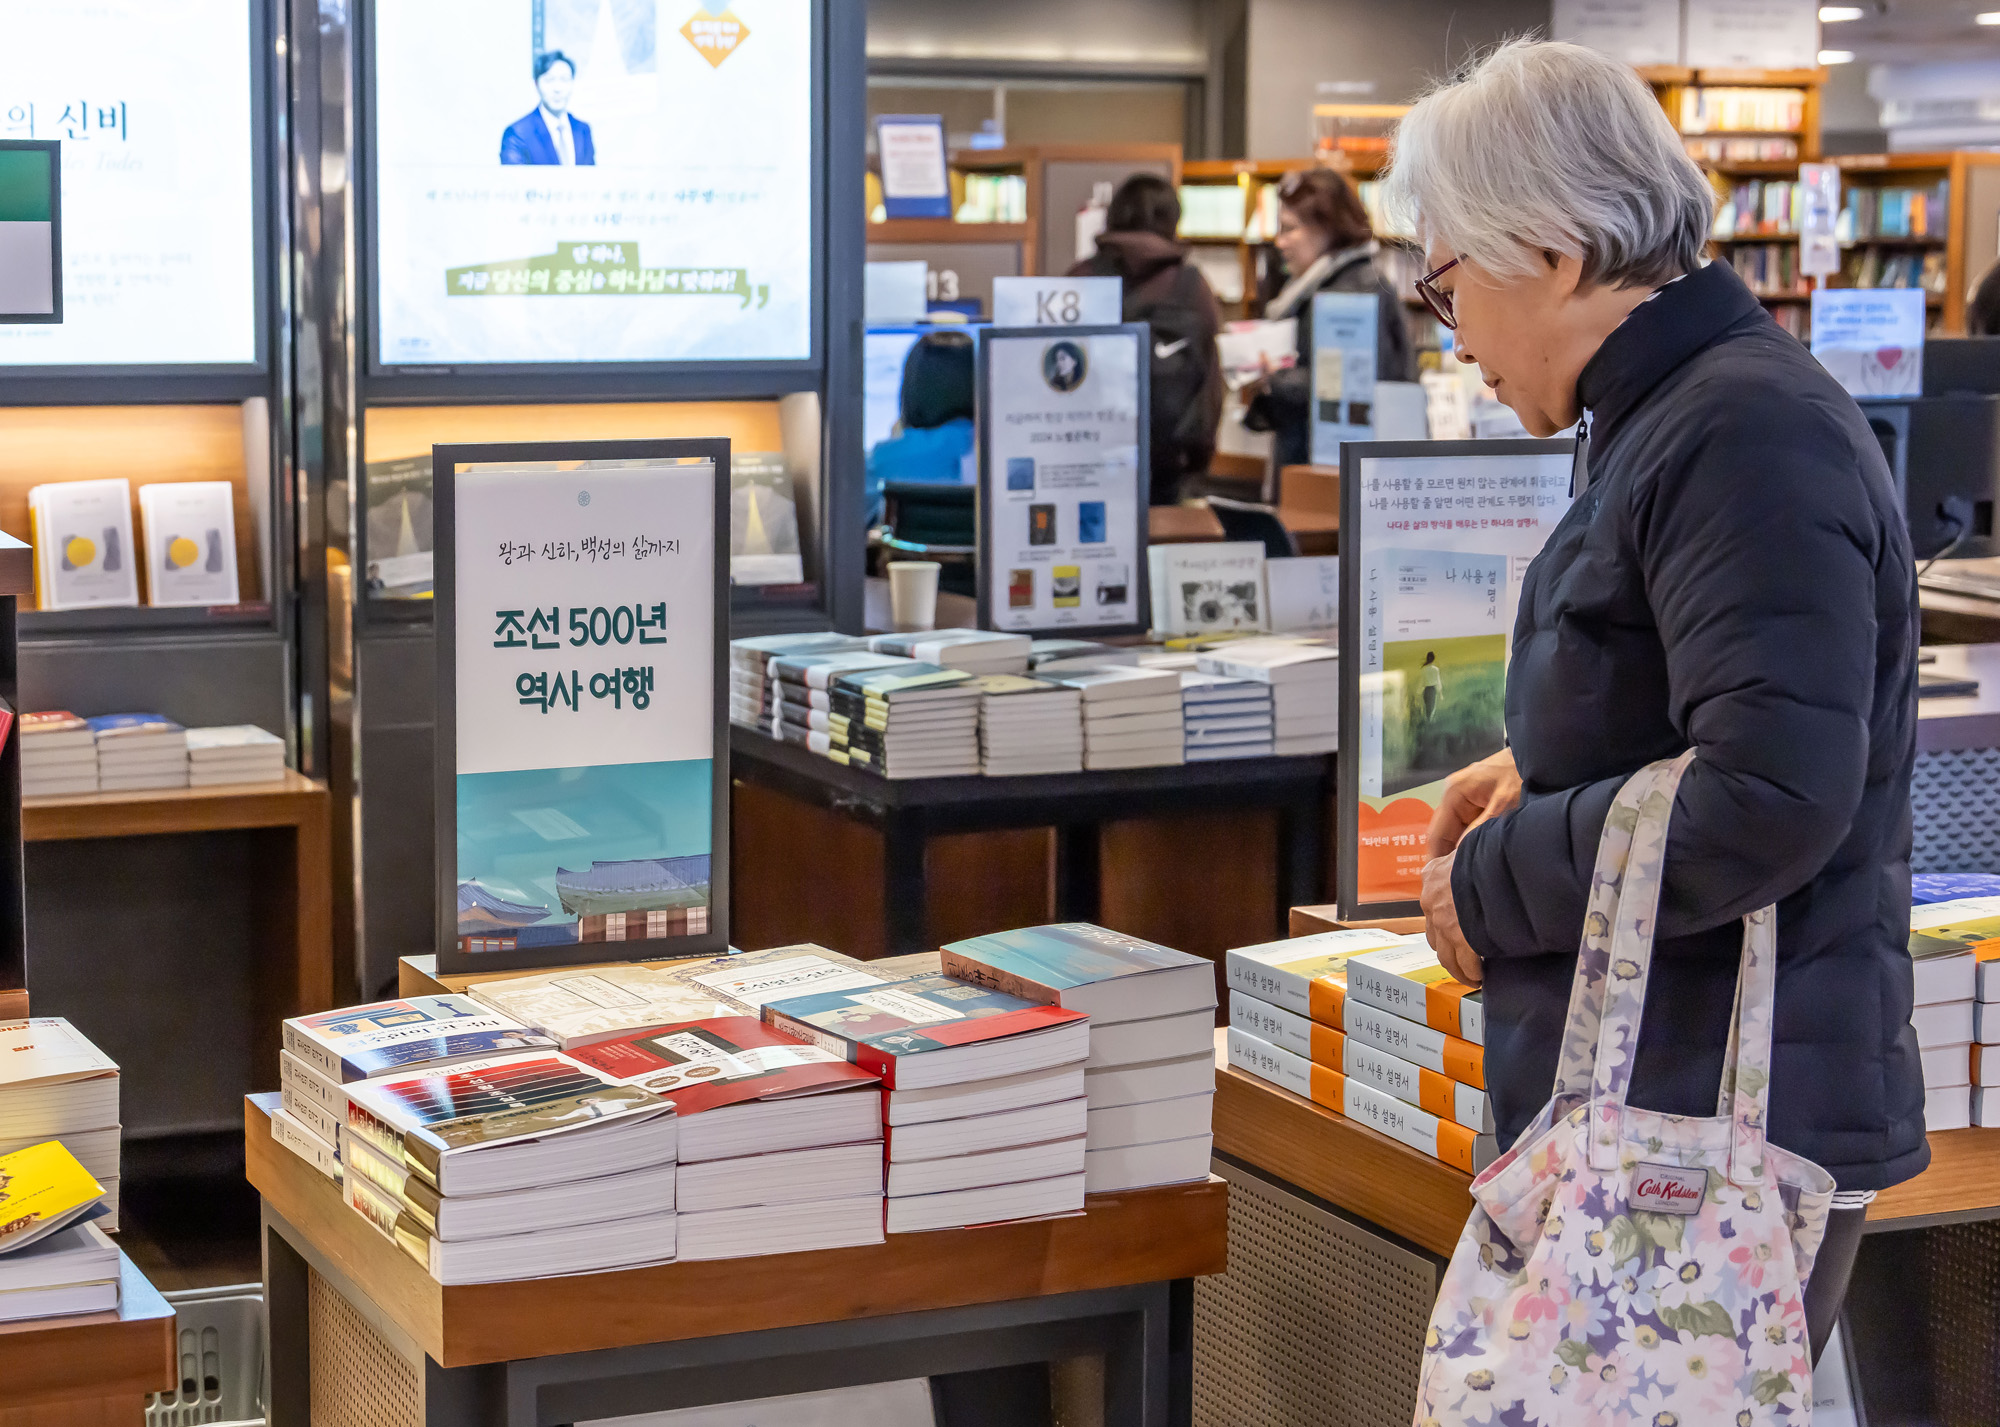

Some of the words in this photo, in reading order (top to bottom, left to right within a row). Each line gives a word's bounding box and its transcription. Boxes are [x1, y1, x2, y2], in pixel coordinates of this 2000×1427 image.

[57, 99, 127, 142] 신비
[1036, 290, 1082, 324] K8
[1383, 478, 1411, 491] 사용할
[1414, 478, 1424, 490] 줄
[1426, 478, 1454, 490] 모르면
[1369, 498, 1388, 511] 나를
[1391, 497, 1420, 510] 사용할
[1422, 497, 1432, 509] 줄
[1434, 497, 1453, 509] 알면
[1455, 496, 1474, 509] 어떤
[1477, 496, 1505, 508] 관계도
[1507, 495, 1535, 507] 두렵지
[1387, 520, 1410, 530] 나다운
[1431, 519, 1453, 530] 방식을
[1455, 519, 1478, 530] 배우는
[1480, 519, 1489, 528] 단
[1491, 518, 1514, 528] 하나의
[1516, 517, 1539, 528] 설명서
[498, 541, 536, 565] 왕과
[632, 534, 681, 560] 삶까지
[1446, 569, 1457, 583] 나
[1461, 569, 1484, 585] 사용
[493, 606, 561, 650] 조선
[568, 601, 668, 648] 500년
[515, 669, 584, 715] 역사
[589, 666, 654, 711] 여행
[1392, 834, 1416, 846] 영향을
[1234, 967, 1241, 980] 나
[1243, 970, 1258, 988] 사용
[1260, 974, 1281, 996] 설명서
[1355, 975, 1363, 990] 나
[1366, 978, 1382, 997] 사용
[1385, 984, 1408, 1006] 설명서
[1237, 1006, 1244, 1019] 나
[1246, 1009, 1260, 1027] 사용
[1262, 1014, 1283, 1037] 설명서
[1355, 1016, 1363, 1032] 나
[1366, 1020, 1382, 1039] 사용
[1385, 1025, 1408, 1048] 설명서
[1234, 1043, 1242, 1056] 나
[1243, 1047, 1258, 1065] 사용
[1260, 1053, 1281, 1074] 설명서
[1357, 1058, 1365, 1072] 나
[1367, 1061, 1384, 1081] 사용
[1386, 1067, 1409, 1090] 설명서
[459, 1073, 526, 1107] 조선왕조실록
[1353, 1096, 1361, 1111] 나
[1363, 1101, 1378, 1120] 사용
[1382, 1107, 1404, 1132] 설명서
[1637, 1178, 1661, 1197] Cath
[1660, 1181, 1699, 1200] Kidston
